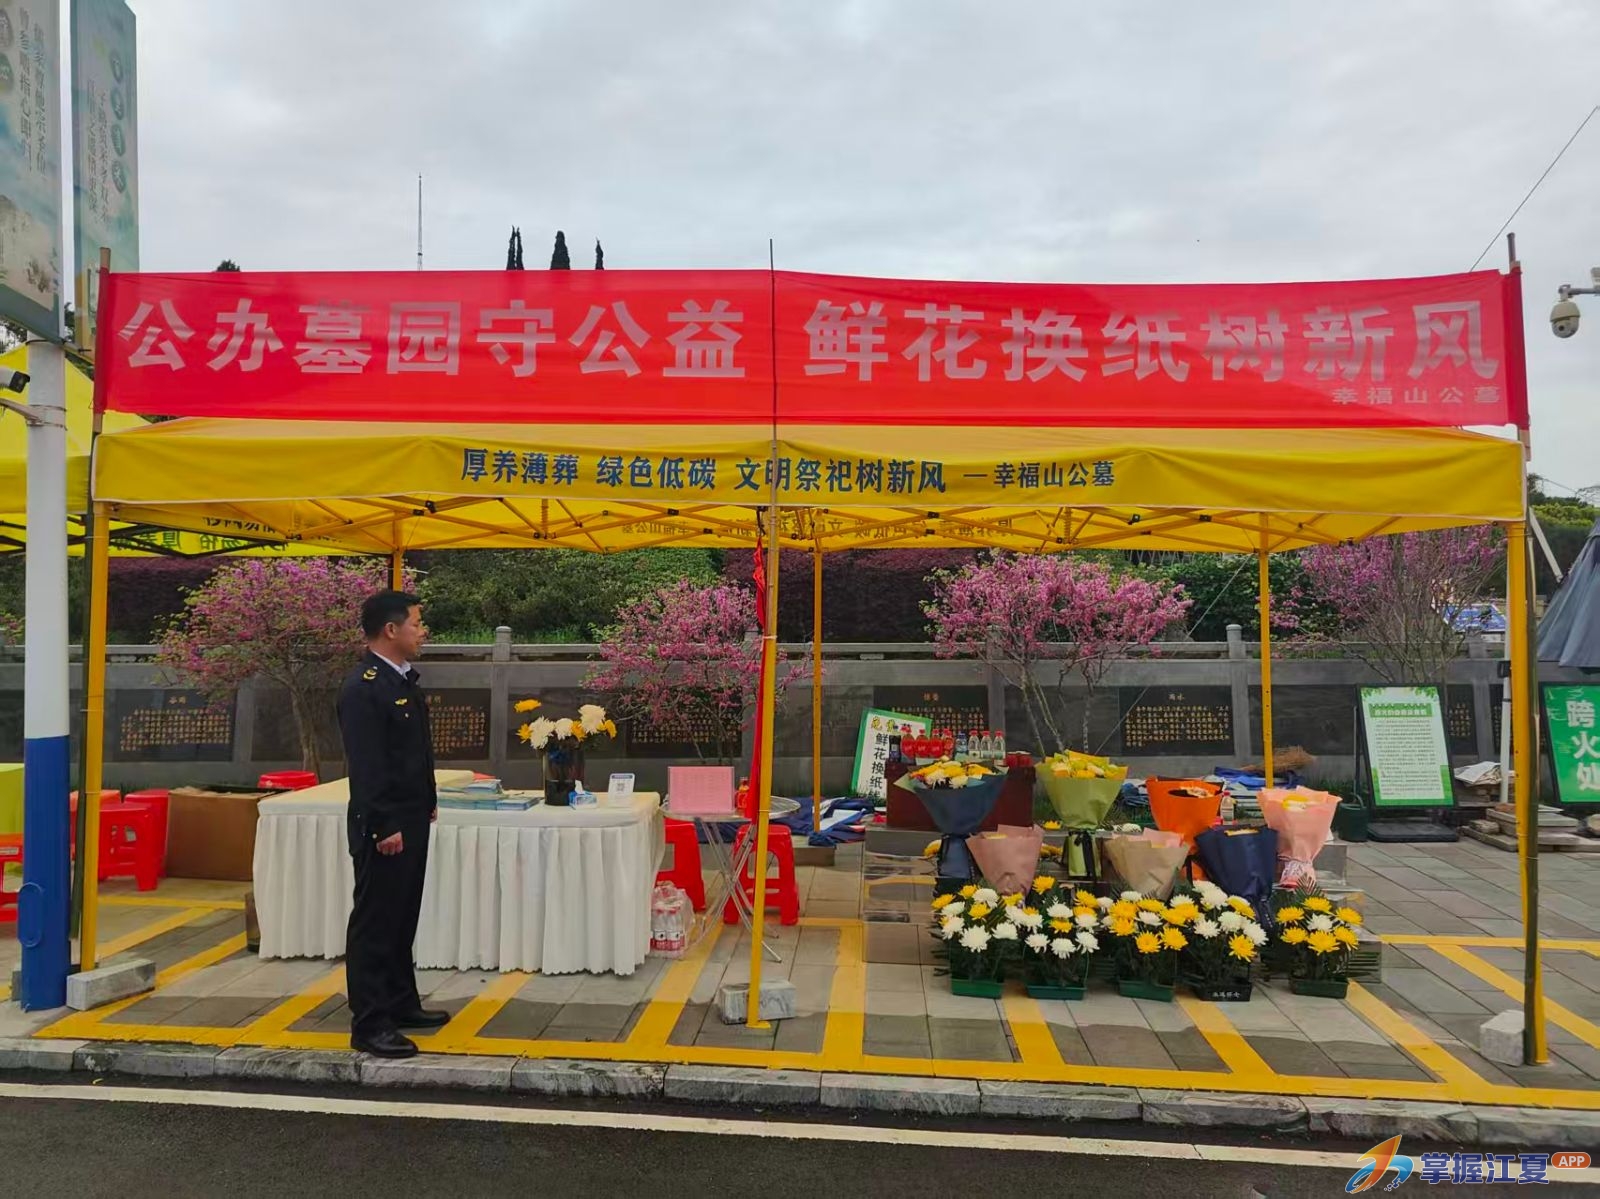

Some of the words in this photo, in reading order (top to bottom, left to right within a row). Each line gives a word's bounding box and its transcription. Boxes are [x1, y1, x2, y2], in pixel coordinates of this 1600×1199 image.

[117, 298, 746, 379] 公办墓园守公益
[803, 299, 1499, 383] 鲜花换纸树新风
[1332, 386, 1500, 405] 幸福山公墓
[461, 448, 579, 485] 厚养薄葬
[596, 455, 716, 490] 绿色低碳
[734, 457, 946, 493] 文明祭祀树新风
